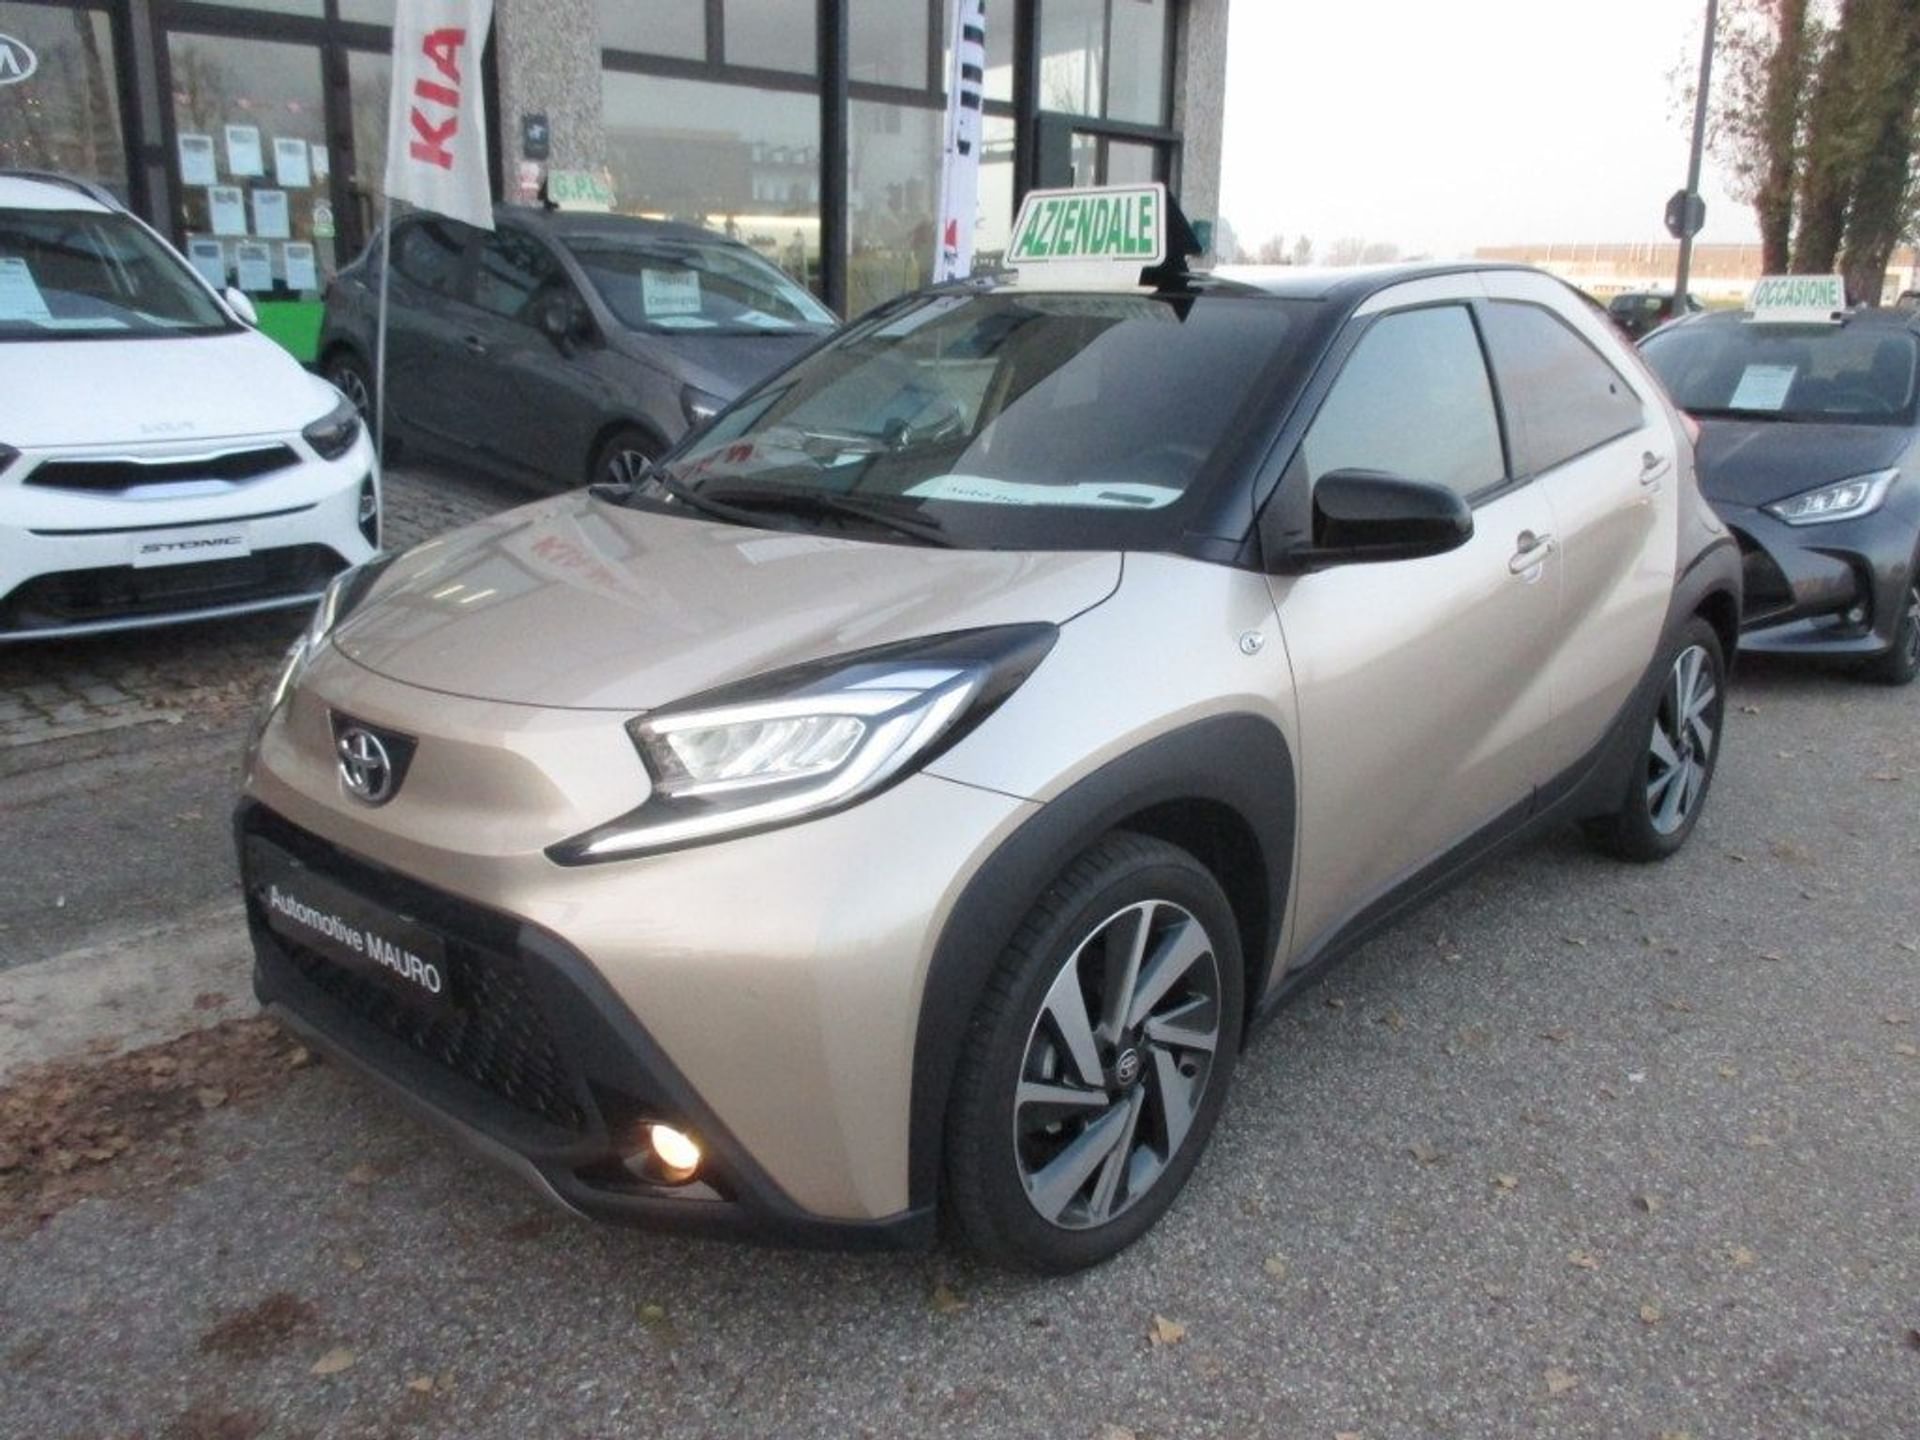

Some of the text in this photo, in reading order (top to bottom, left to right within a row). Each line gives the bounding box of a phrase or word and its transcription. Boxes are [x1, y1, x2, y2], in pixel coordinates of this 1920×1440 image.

[410, 28, 466, 170] KIA
[1014, 196, 1152, 257] AZIENDALE
[1755, 281, 1837, 306] OCCASIONE
[141, 536, 243, 554] STONIC
[271, 884, 441, 993] Automotive MAURO
